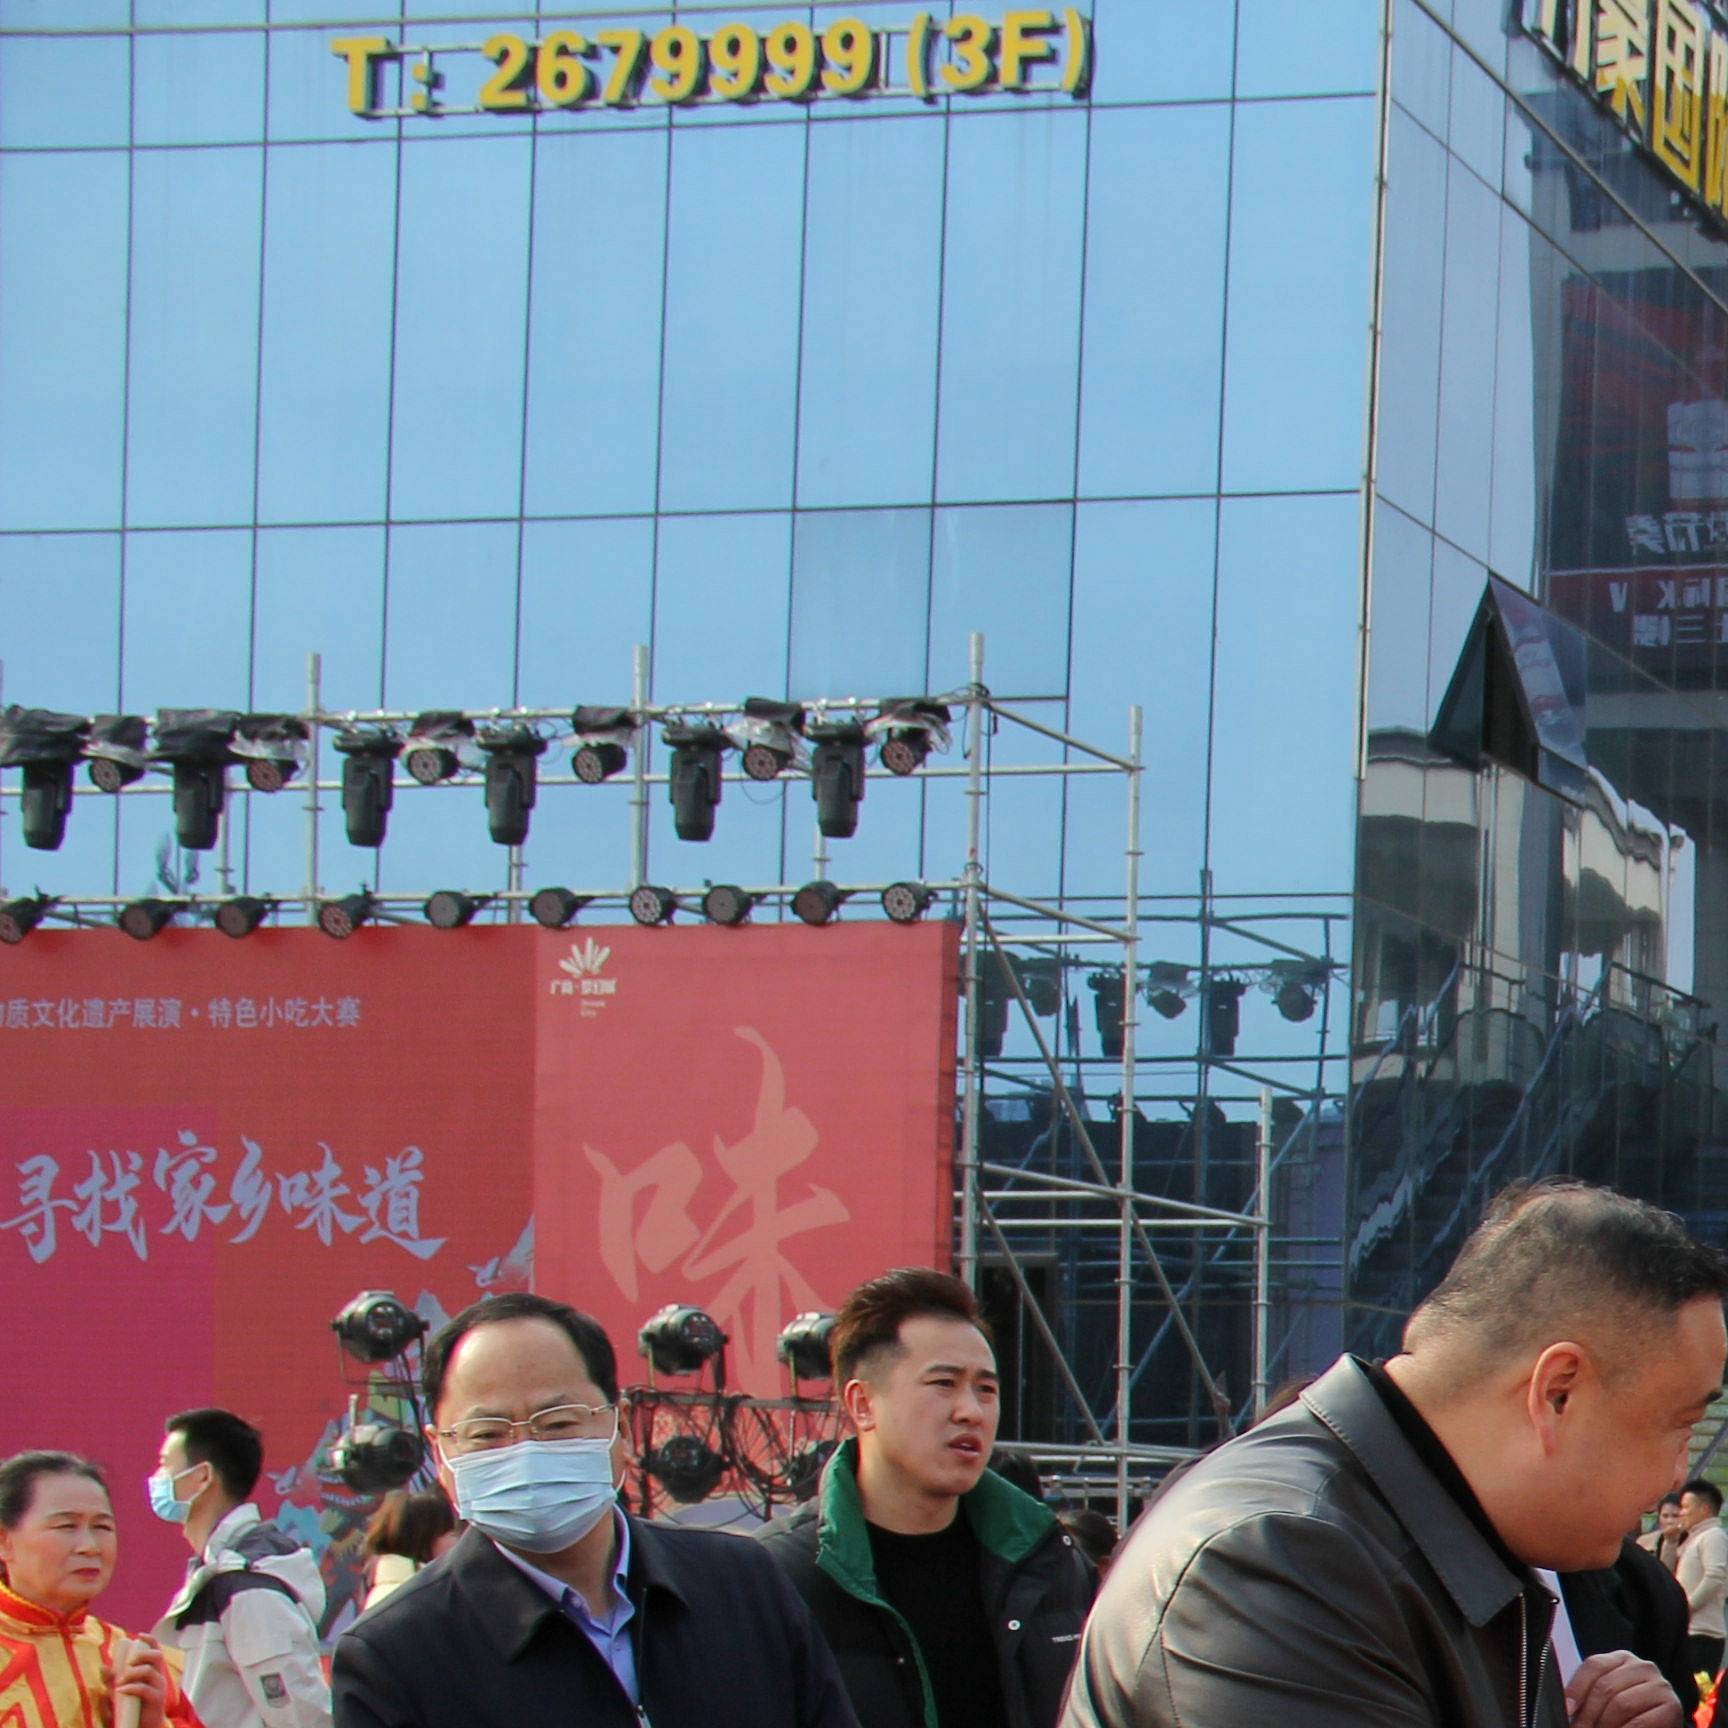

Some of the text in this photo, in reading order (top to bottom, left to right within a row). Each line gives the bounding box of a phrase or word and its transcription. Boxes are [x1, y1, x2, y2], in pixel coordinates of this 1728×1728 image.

[478, 18, 878, 107] 2679999
[906, 8, 1086, 96] (3F)
[0, 996, 362, 1029] 质文化遗产展演·特色小吃大赛
[0, 1129, 448, 1265] 寻找家乡味道
